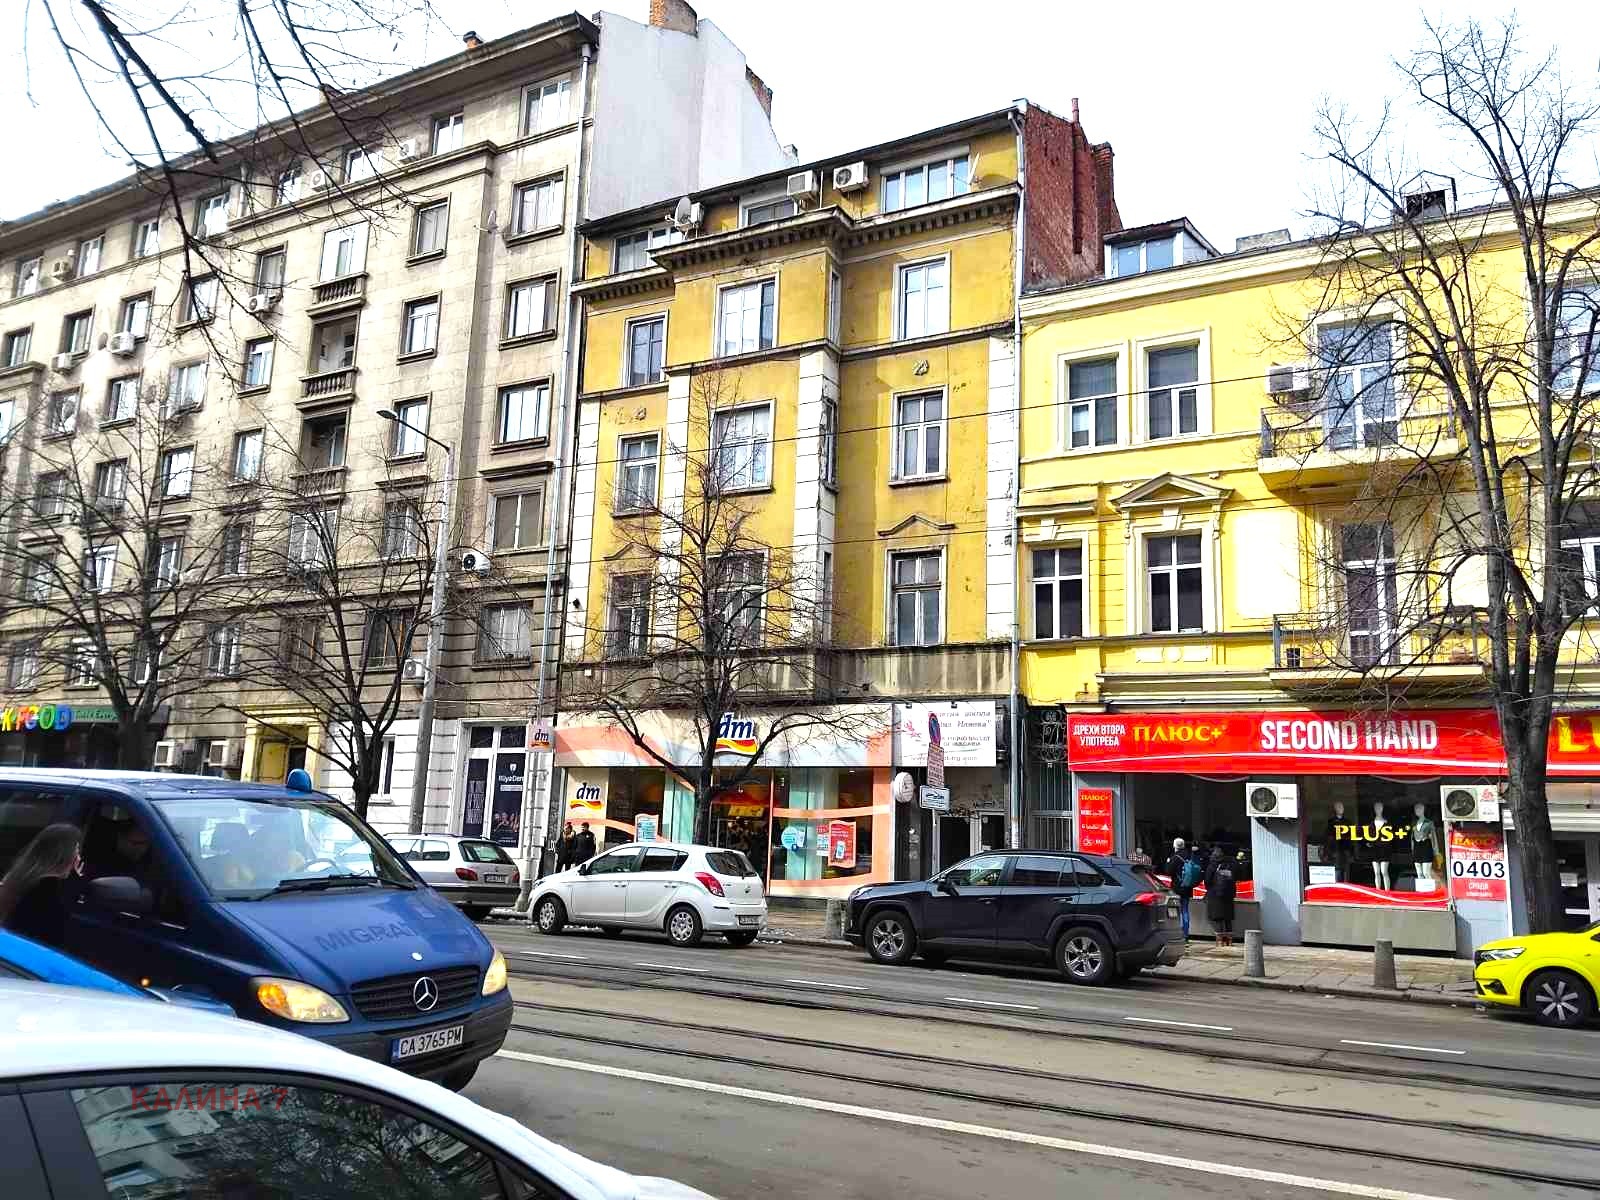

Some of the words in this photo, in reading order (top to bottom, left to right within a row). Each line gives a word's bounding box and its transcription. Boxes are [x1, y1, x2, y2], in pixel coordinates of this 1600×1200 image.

[534, 728, 550, 741] dm
[719, 713, 753, 739] dm
[1073, 724, 1099, 736] ДРЕХИ
[1100, 724, 1126, 735] ВТОРА
[1261, 720, 1358, 750] SECOND
[1365, 719, 1438, 750] HAND
[1080, 736, 1120, 747] УПОТРЕБА
[576, 782, 600, 800] dm
[1453, 861, 1505, 878] 0403
[400, 1039, 416, 1055] CA
[418, 1031, 446, 1051] 3765
[447, 1028, 462, 1045] PM
